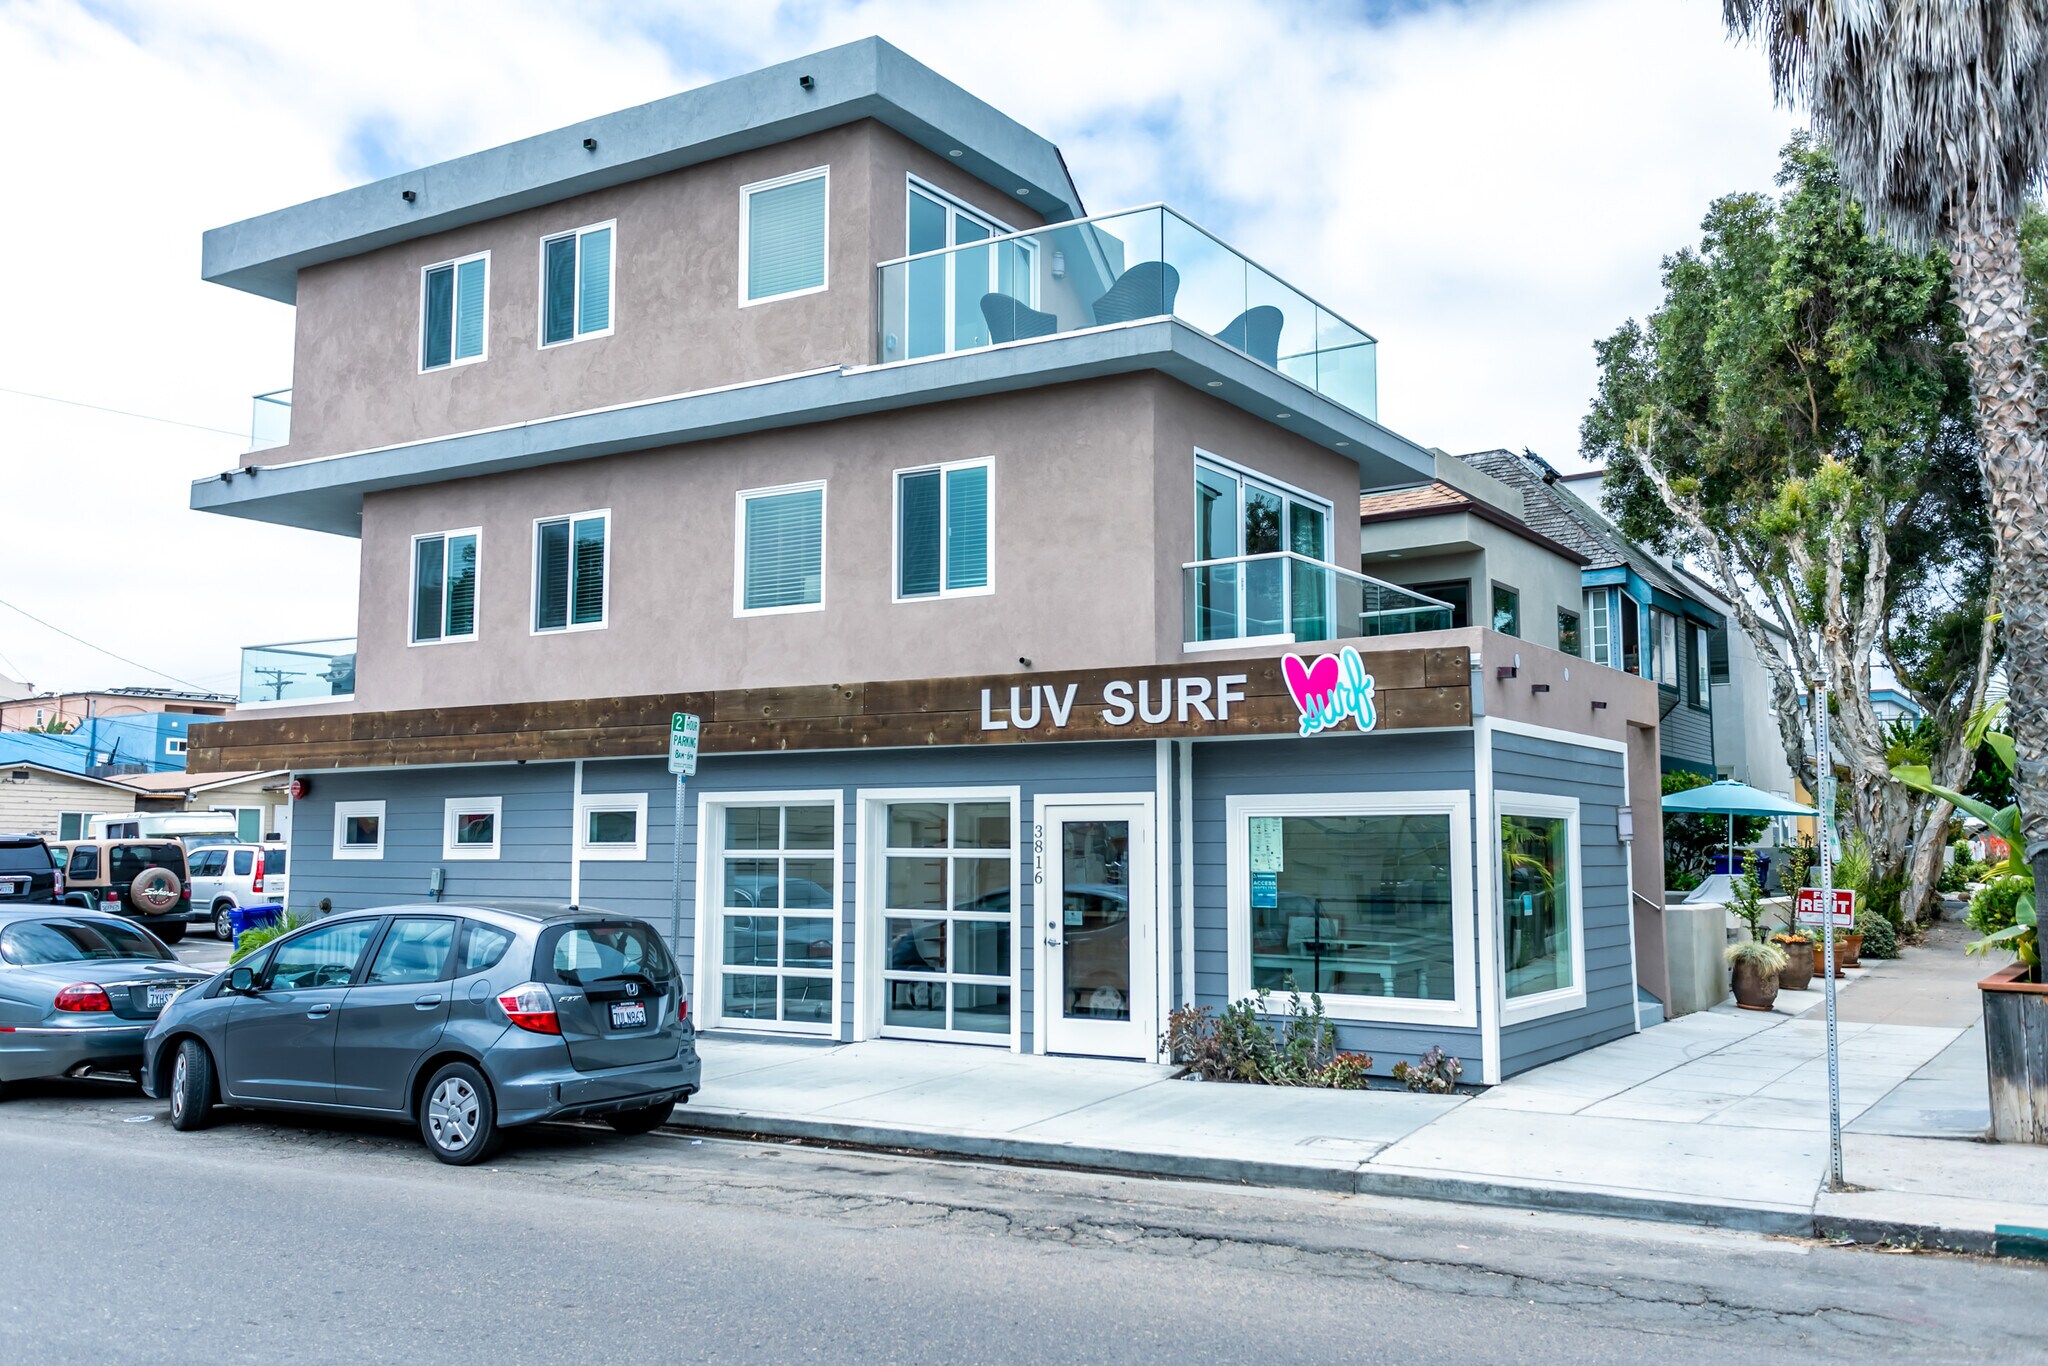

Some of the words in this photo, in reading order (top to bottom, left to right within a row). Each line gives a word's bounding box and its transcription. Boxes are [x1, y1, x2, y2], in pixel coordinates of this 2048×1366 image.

[980, 683, 1078, 731] LUV
[1102, 673, 1248, 727] SURF
[675, 715, 683, 730] 2
[674, 735, 696, 748] PARKING
[1034, 824, 1043, 885] 3816
